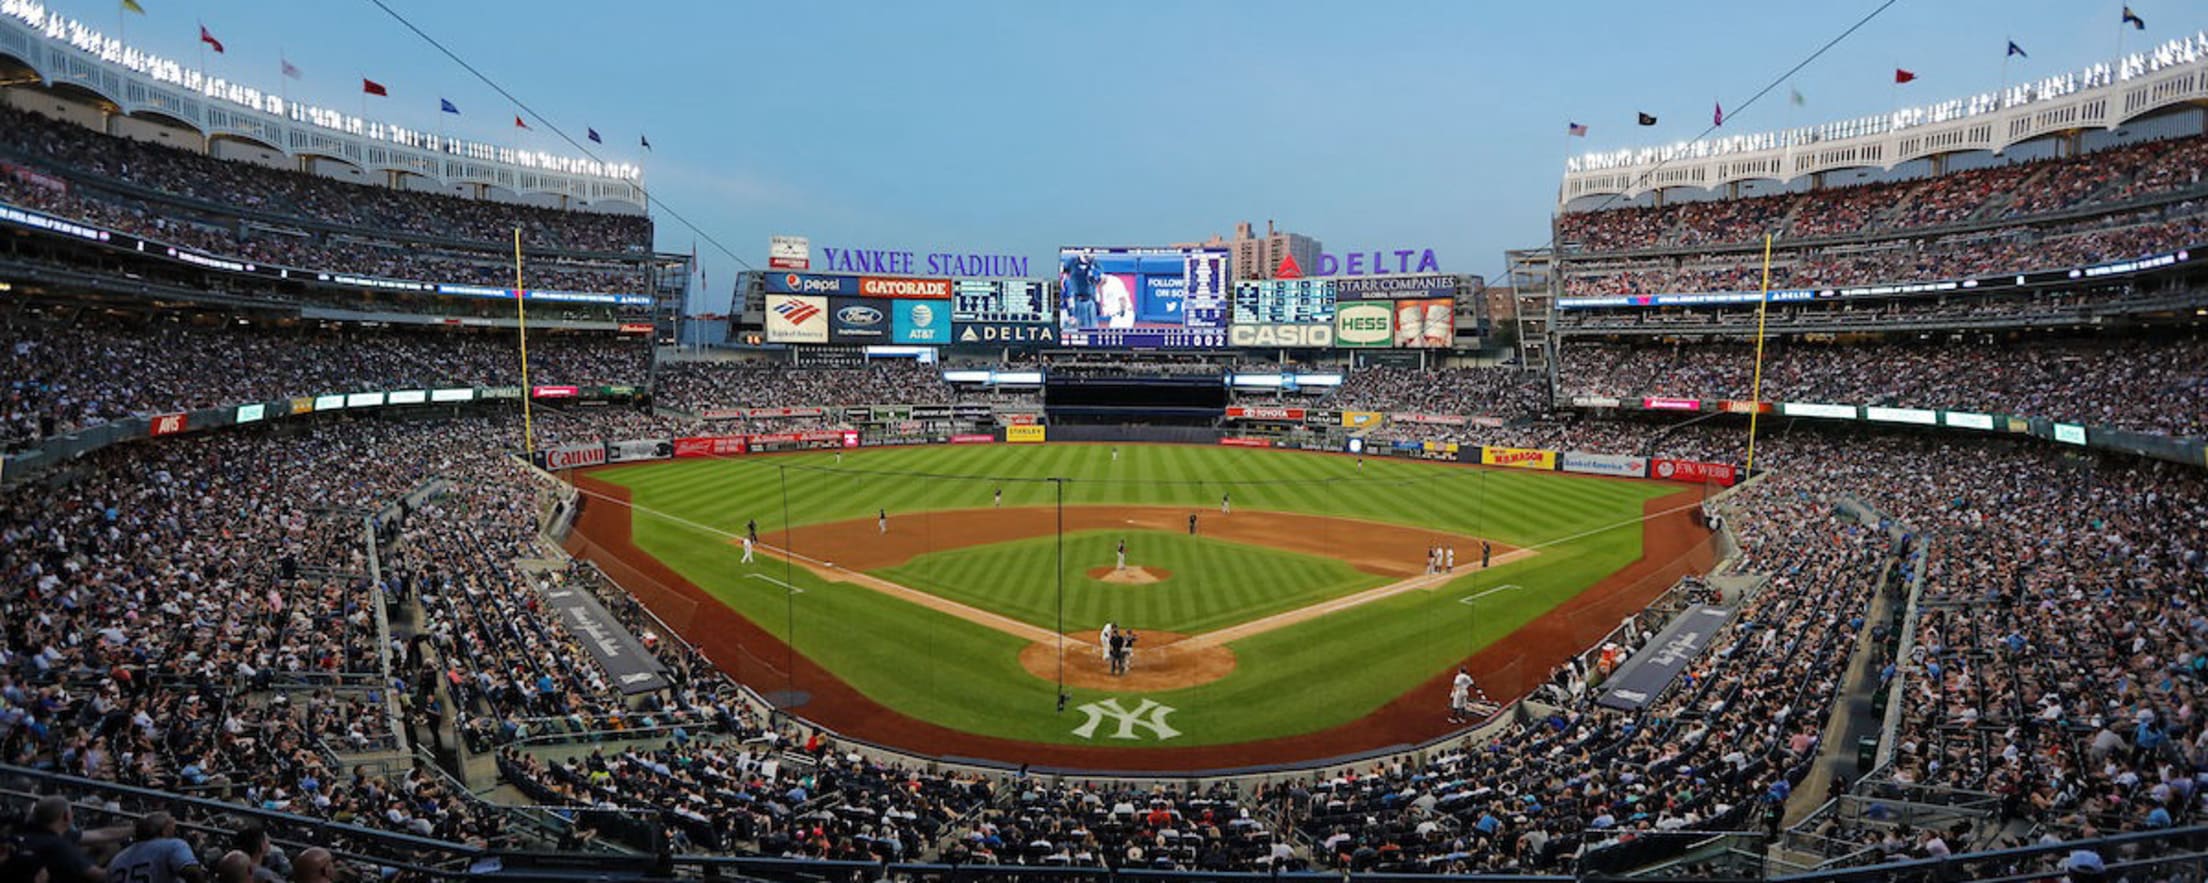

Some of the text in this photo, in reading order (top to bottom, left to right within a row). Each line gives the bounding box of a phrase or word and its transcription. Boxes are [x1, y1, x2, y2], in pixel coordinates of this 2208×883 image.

[824, 248, 1029, 277] YANKEE STADIUM
[1316, 248, 1440, 276] DELTA
[803, 278, 840, 292] pepsi
[865, 281, 946, 296] GATORADE
[1148, 278, 1184, 288] FOLLOW
[1339, 276, 1454, 292] STARR COMPANIES
[1155, 288, 1169, 298] ON
[1361, 291, 1388, 299] GLOBAL
[845, 308, 874, 322] Ford
[1341, 316, 1388, 331] HESS
[909, 329, 936, 340] AT&T
[983, 326, 1053, 341] DELTA
[1231, 325, 1333, 346] CASIO
[1193, 336, 1225, 347] 0 0 2
[1256, 409, 1289, 418] TOYOTA
[158, 415, 180, 434] AVIS
[547, 446, 604, 468] Canon
[1565, 459, 1583, 467] Bank
[1592, 461, 1623, 471] America
[1698, 464, 1730, 478] WEBB
[1071, 698, 1182, 740] NY
